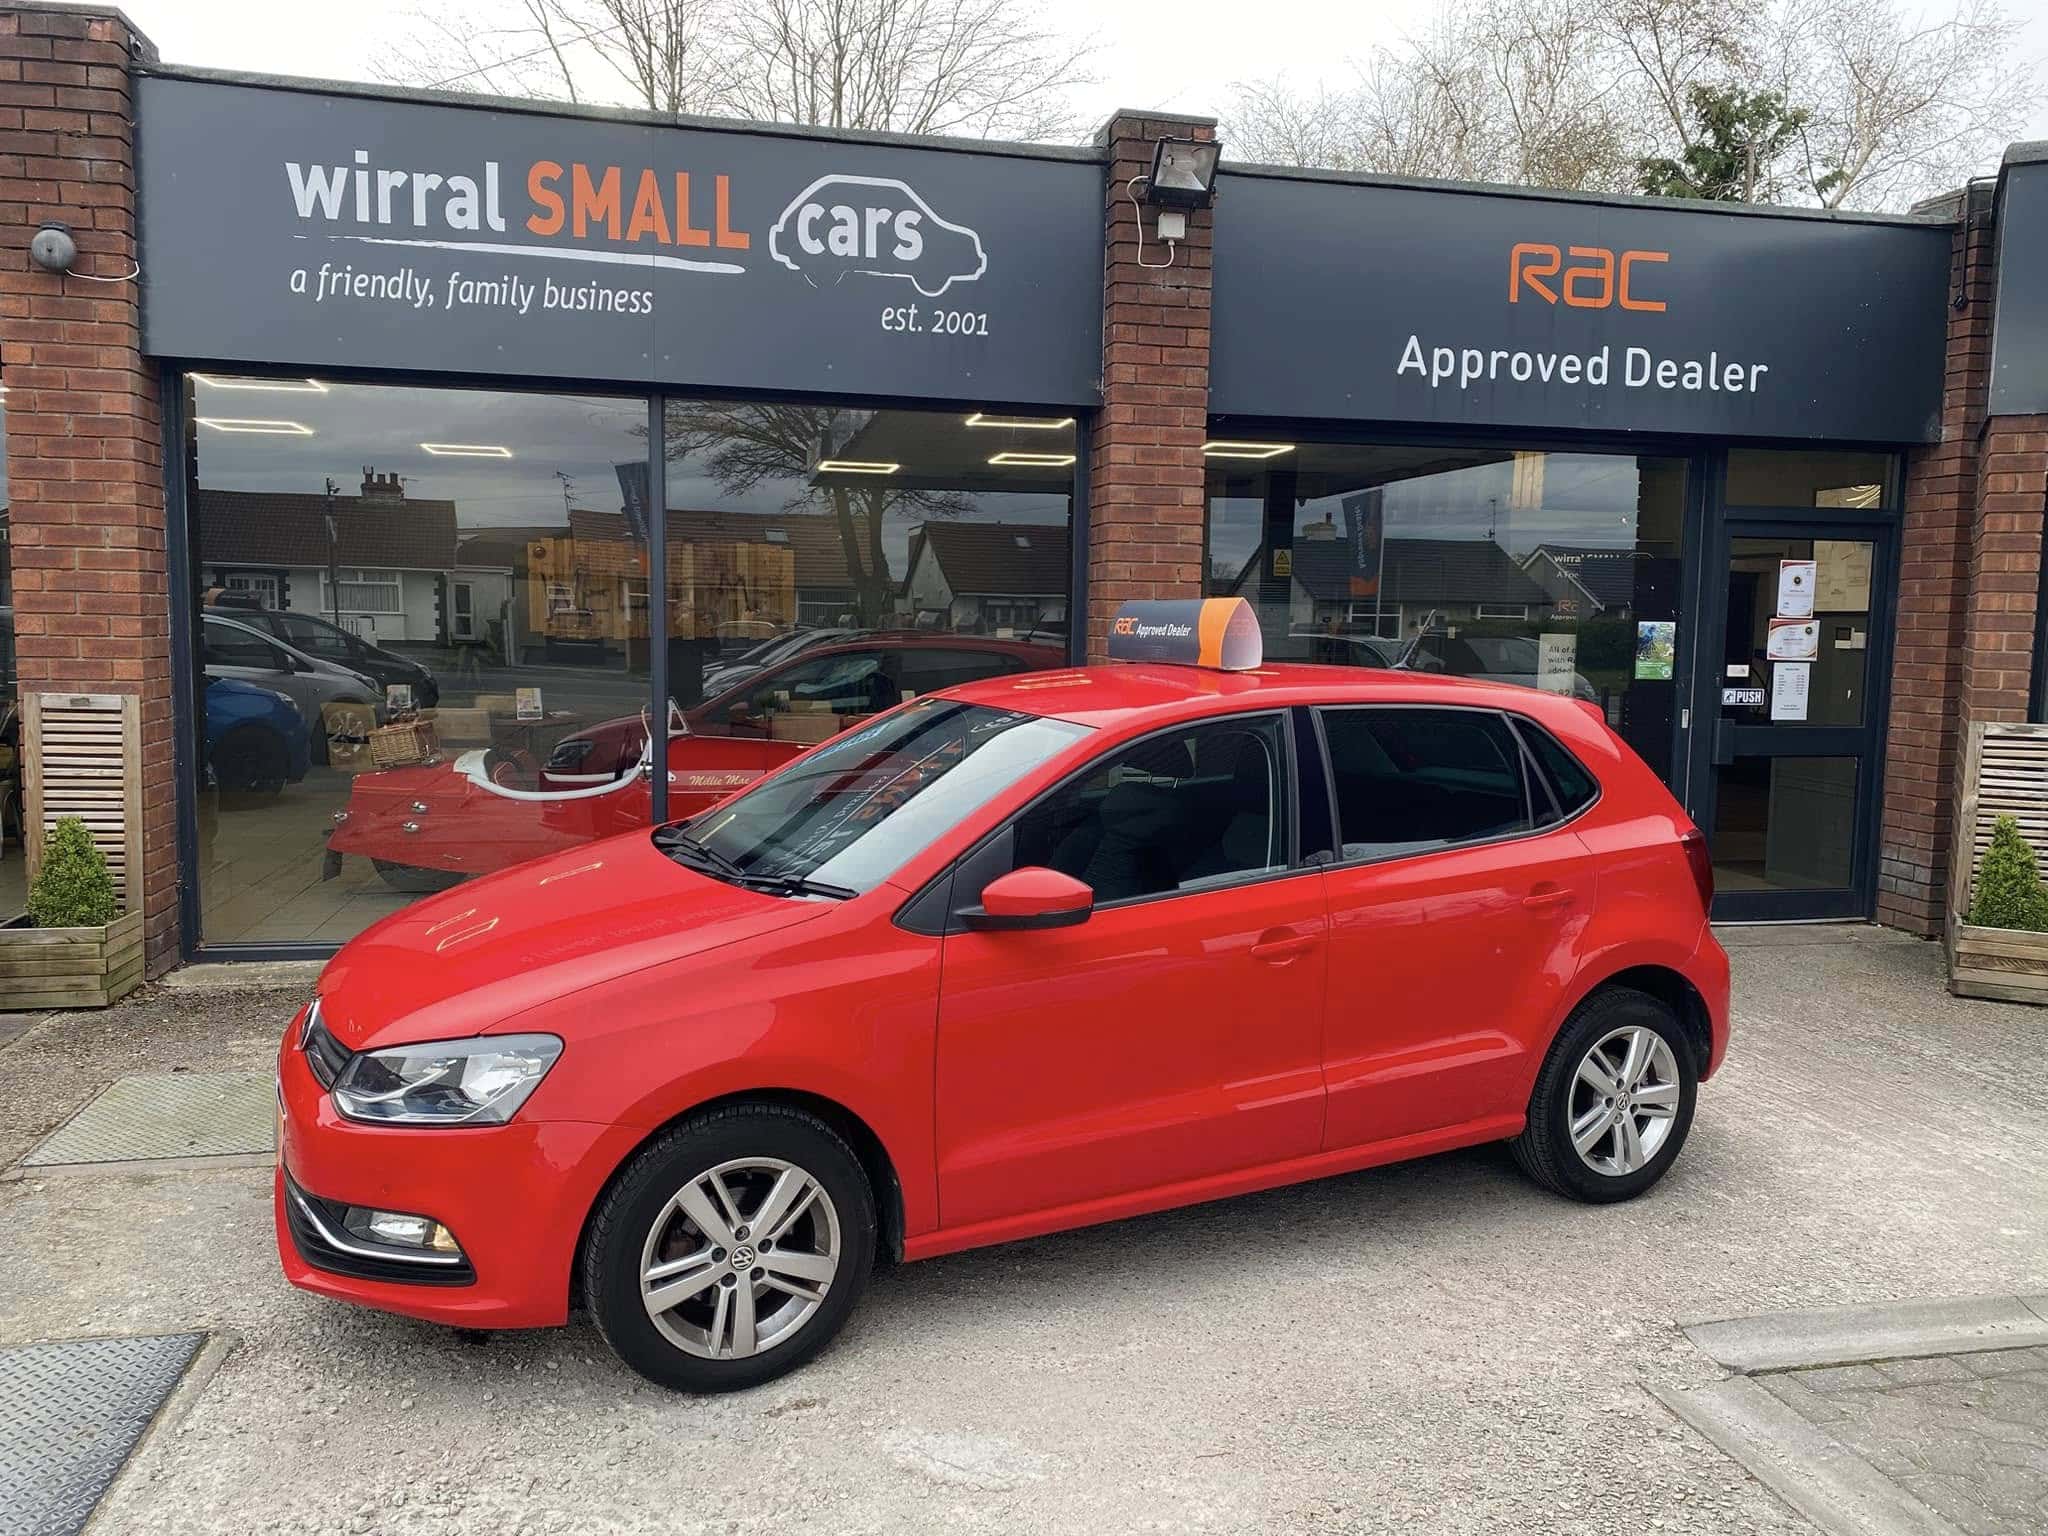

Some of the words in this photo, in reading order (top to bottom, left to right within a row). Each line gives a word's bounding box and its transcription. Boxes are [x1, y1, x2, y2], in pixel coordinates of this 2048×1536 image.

[284, 149, 505, 232] wirral
[525, 160, 750, 249] SMALL
[796, 202, 923, 260] cars
[289, 267, 307, 294] a
[314, 263, 435, 308] friendly,
[445, 271, 534, 316] family
[543, 277, 653, 314] business
[880, 305, 923, 332] est.
[932, 307, 989, 336] 2001
[1397, 335, 1609, 389] Approved
[1624, 346, 1769, 392] Dealer
[1136, 623, 1167, 638] Approved
[1167, 624, 1192, 637] Dealer
[1736, 691, 1762, 703] PUSH
